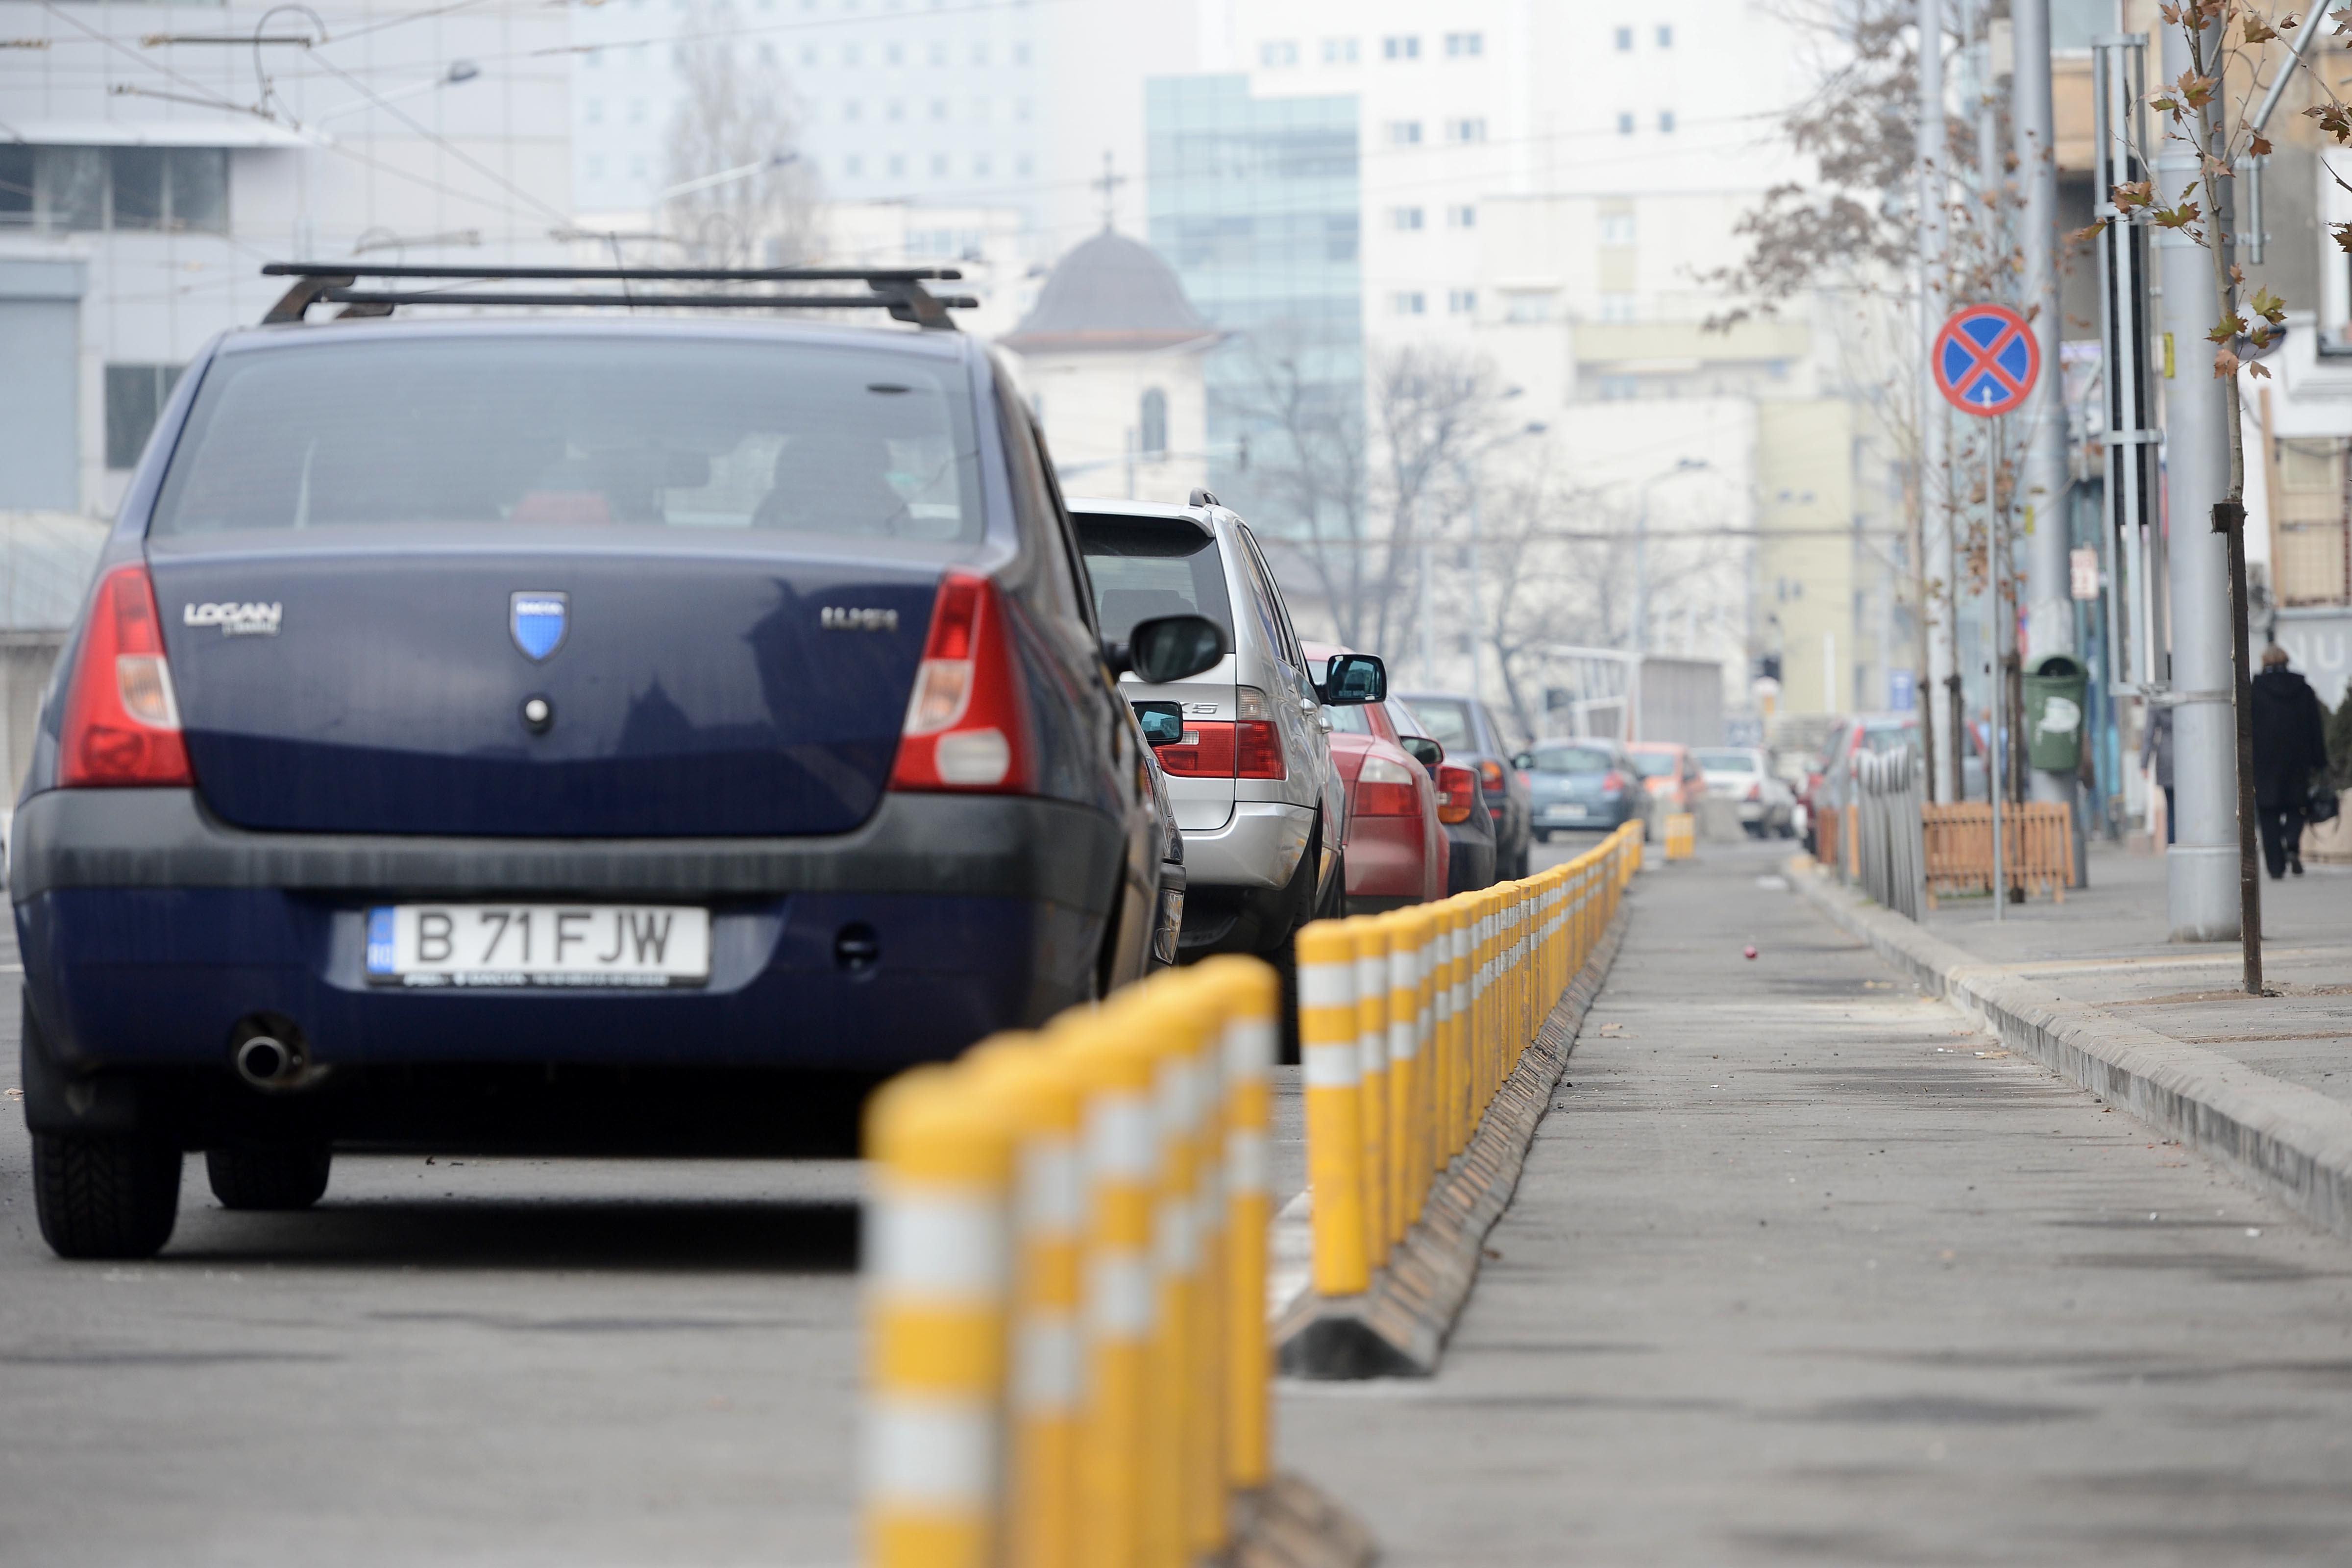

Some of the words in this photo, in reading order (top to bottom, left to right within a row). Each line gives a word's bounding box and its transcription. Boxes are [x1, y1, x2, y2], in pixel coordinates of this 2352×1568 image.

[184, 602, 282, 626] LOGAN
[417, 912, 453, 963] B
[481, 912, 531, 963] 71
[554, 912, 672, 964] FJW
